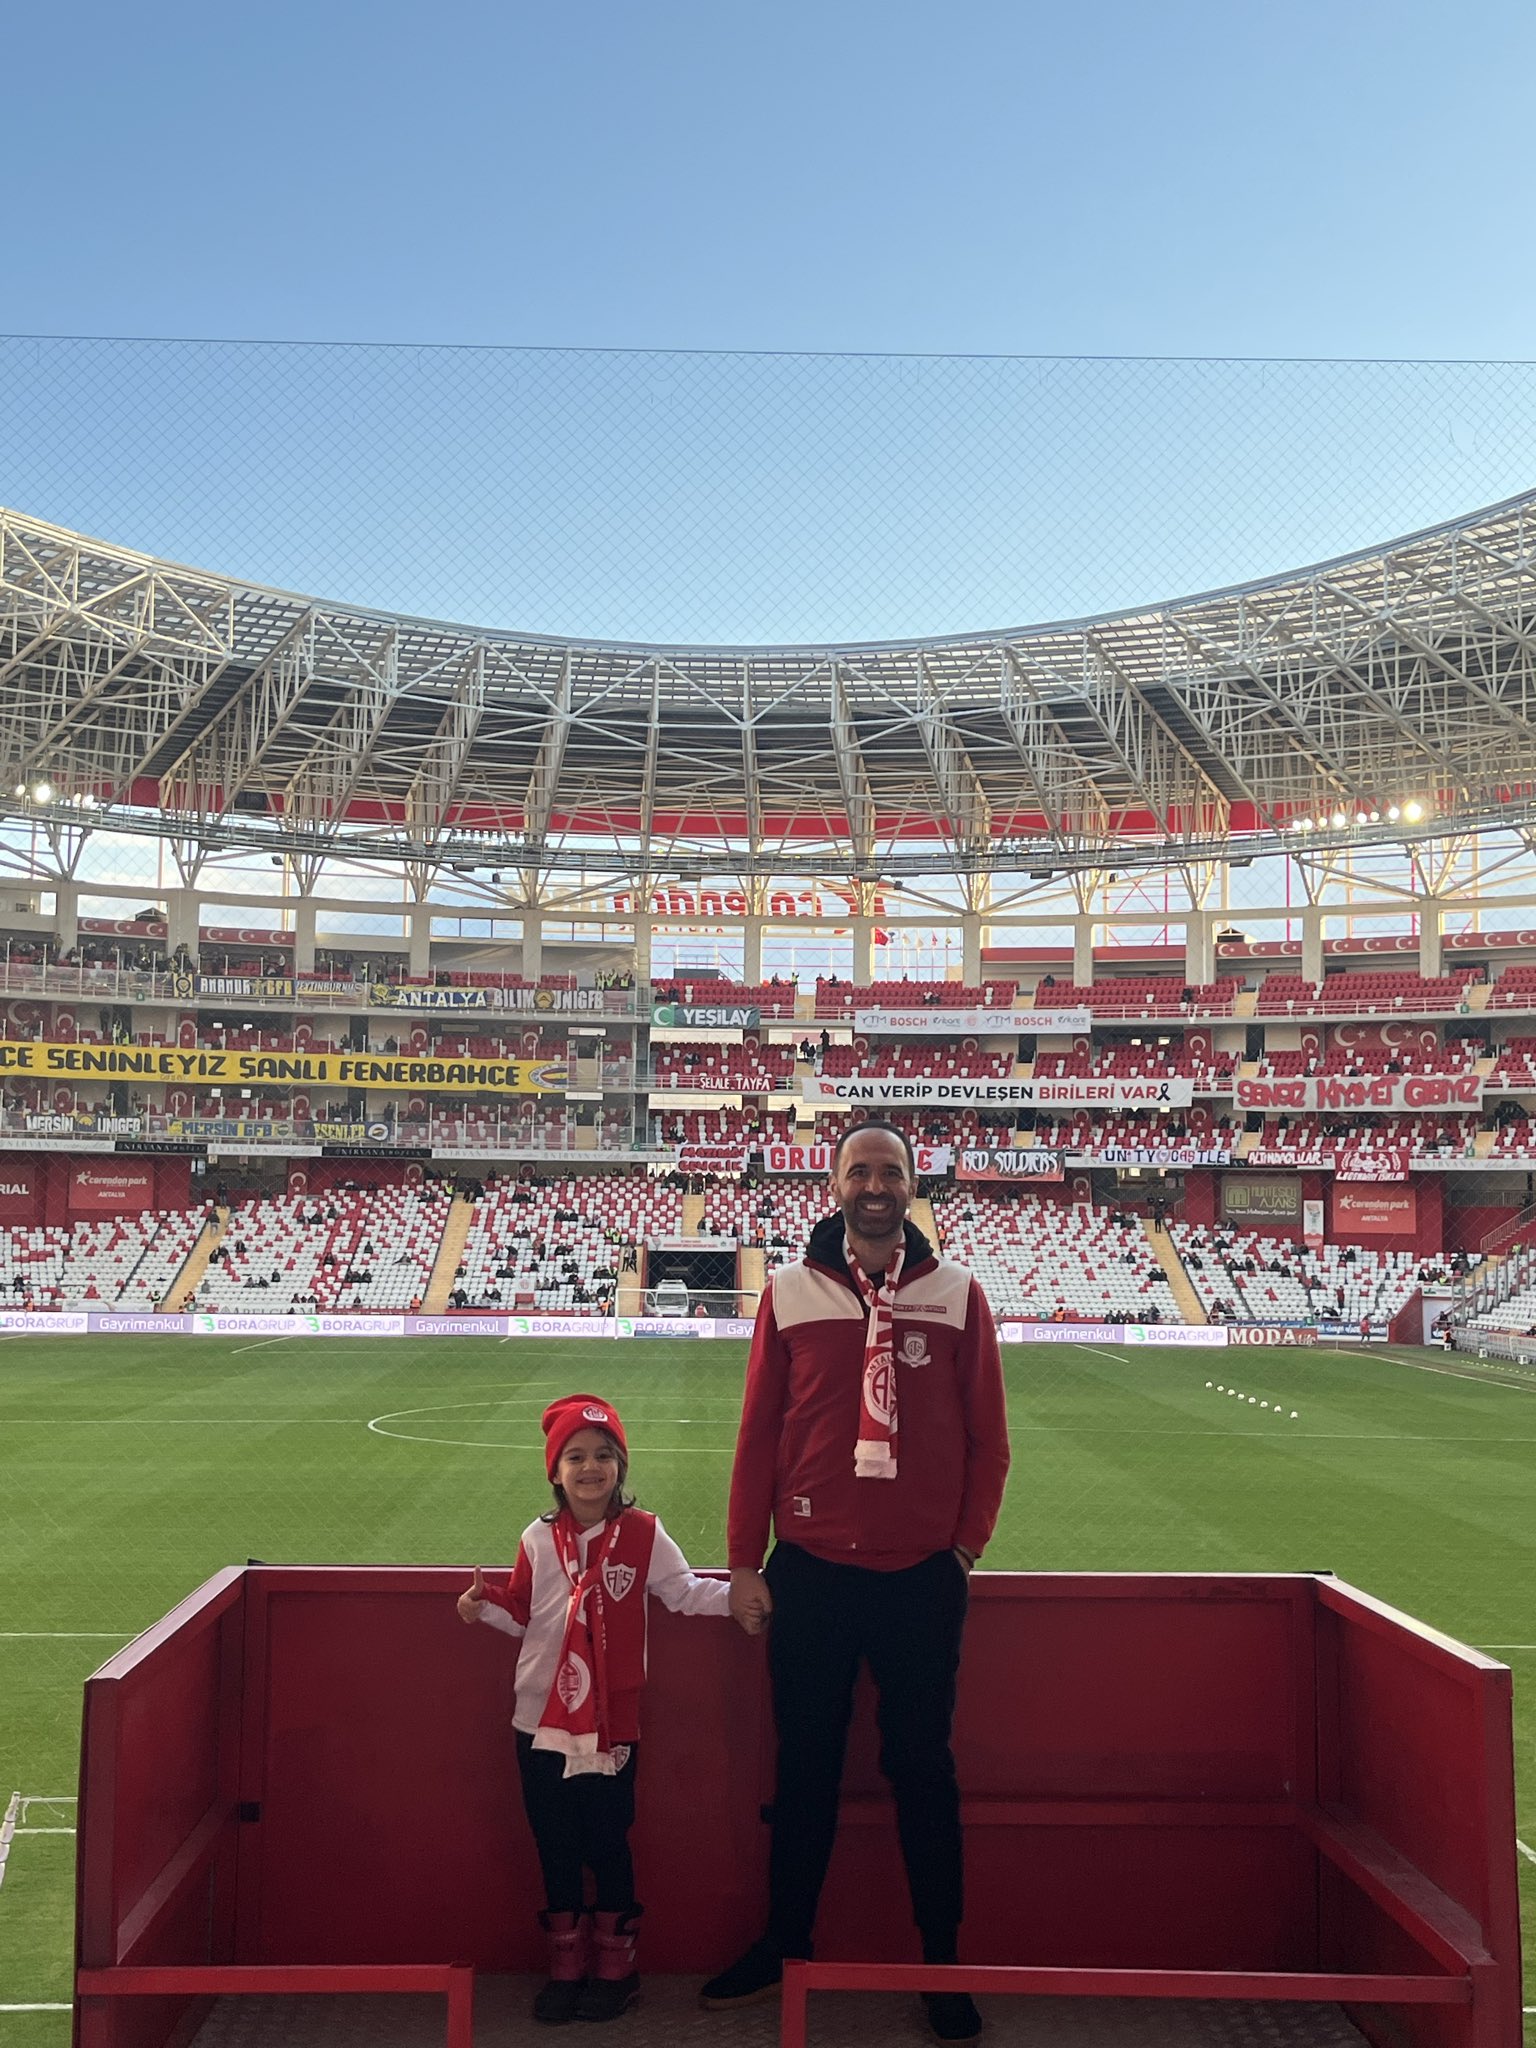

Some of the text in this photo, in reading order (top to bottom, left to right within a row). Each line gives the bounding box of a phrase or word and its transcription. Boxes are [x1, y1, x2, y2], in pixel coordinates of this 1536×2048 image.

[397, 990, 487, 1007] ANTALYA
[890, 1017, 927, 1026] BOSCH
[1014, 1017, 1052, 1026] BOSCH
[47, 1048, 226, 1076] SENİNLEYİZ
[239, 1057, 327, 1080] ŞANLI
[339, 1061, 520, 1086] FENERBAHÇE
[835, 1082, 1158, 1101] CAN VERİP DEVLEŞEN BİRİLERİ VAR
[244, 1122, 272, 1137] GFB
[123, 1143, 170, 1151] NIRVANA
[341, 1147, 385, 1156] NIRVANA
[962, 1151, 1058, 1173] RED SOLDIERS
[1171, 1150, 1226, 1164] CASTLE
[128, 1176, 148, 1187] park
[1260, 1197, 1297, 1208] AJANS
[1390, 1200, 1409, 1210] park
[99, 1317, 184, 1331] Gayrimenkul
[218, 1319, 296, 1330] BORAGRUP
[323, 1320, 400, 1331] BORAGRUP
[416, 1320, 499, 1334] Gayrimenkul
[532, 1321, 608, 1333] BORAGRUP
[1034, 1327, 1116, 1341] Gayrimenkul
[1148, 1329, 1224, 1341] BORAGRUP
[1229, 1328, 1297, 1344] MODA
